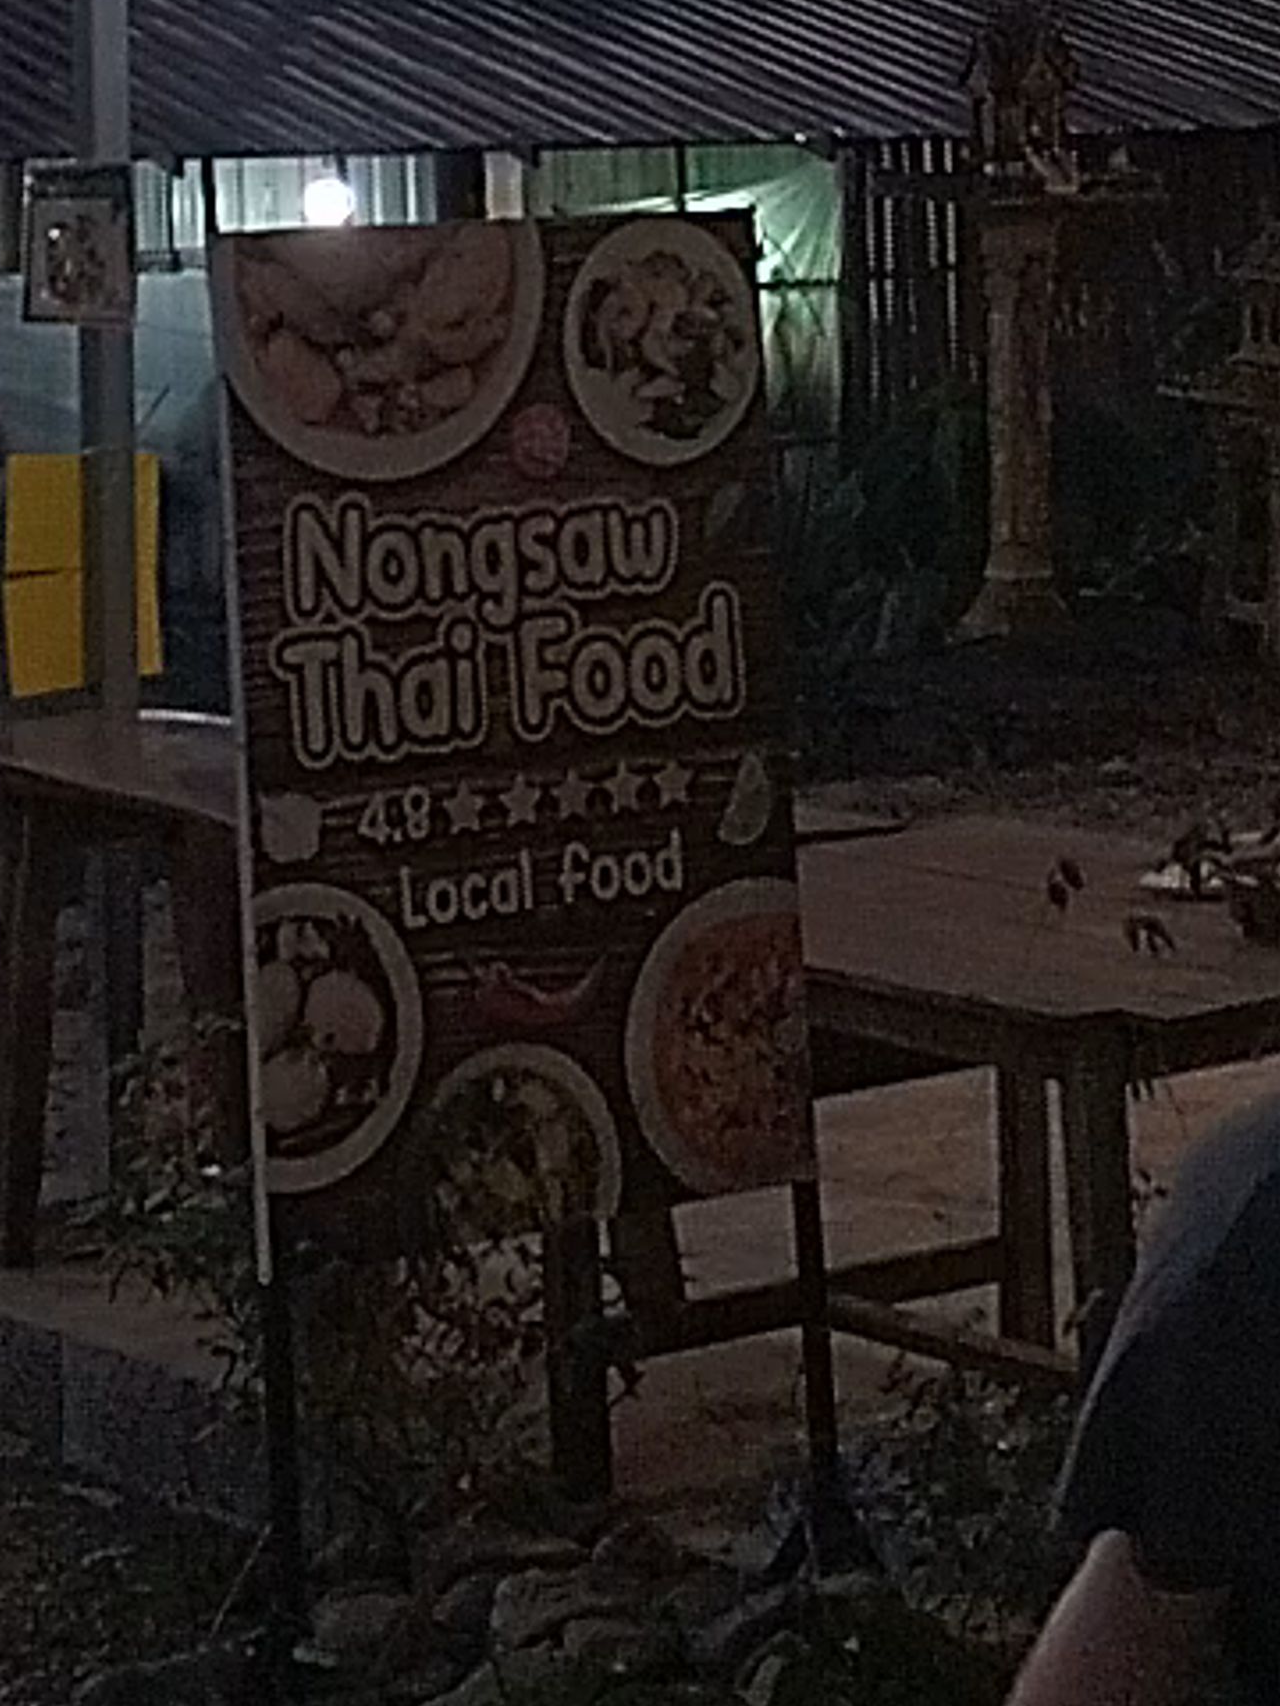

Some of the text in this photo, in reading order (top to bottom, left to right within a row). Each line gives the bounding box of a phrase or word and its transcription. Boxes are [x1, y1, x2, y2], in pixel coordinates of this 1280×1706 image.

[283, 493, 677, 632] Nongsaw
[270, 581, 745, 770] Thai Food
[357, 786, 432, 846] 4.8
[399, 826, 684, 930] Local food
